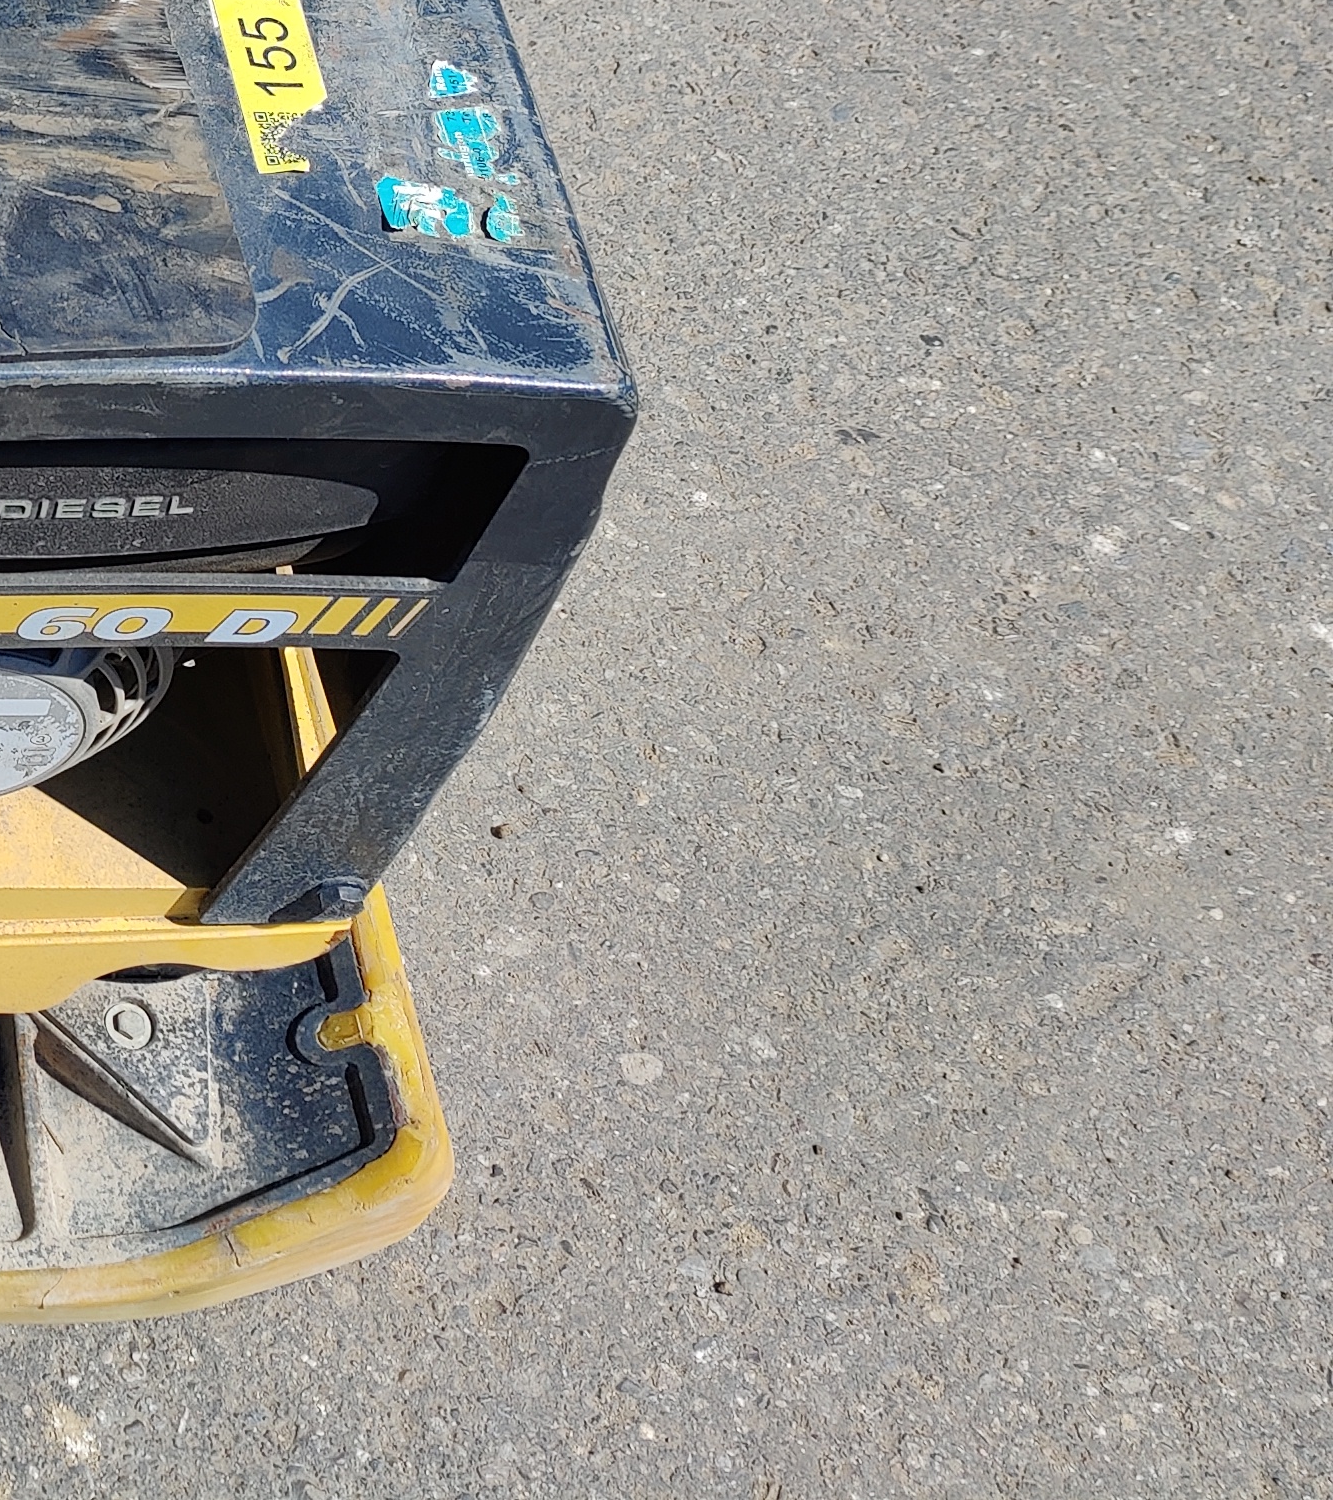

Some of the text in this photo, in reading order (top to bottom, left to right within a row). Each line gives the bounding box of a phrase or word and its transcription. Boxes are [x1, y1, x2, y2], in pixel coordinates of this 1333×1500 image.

[237, 16, 304, 97] 155
[16, 605, 174, 642] 60
[203, 607, 299, 643] D
